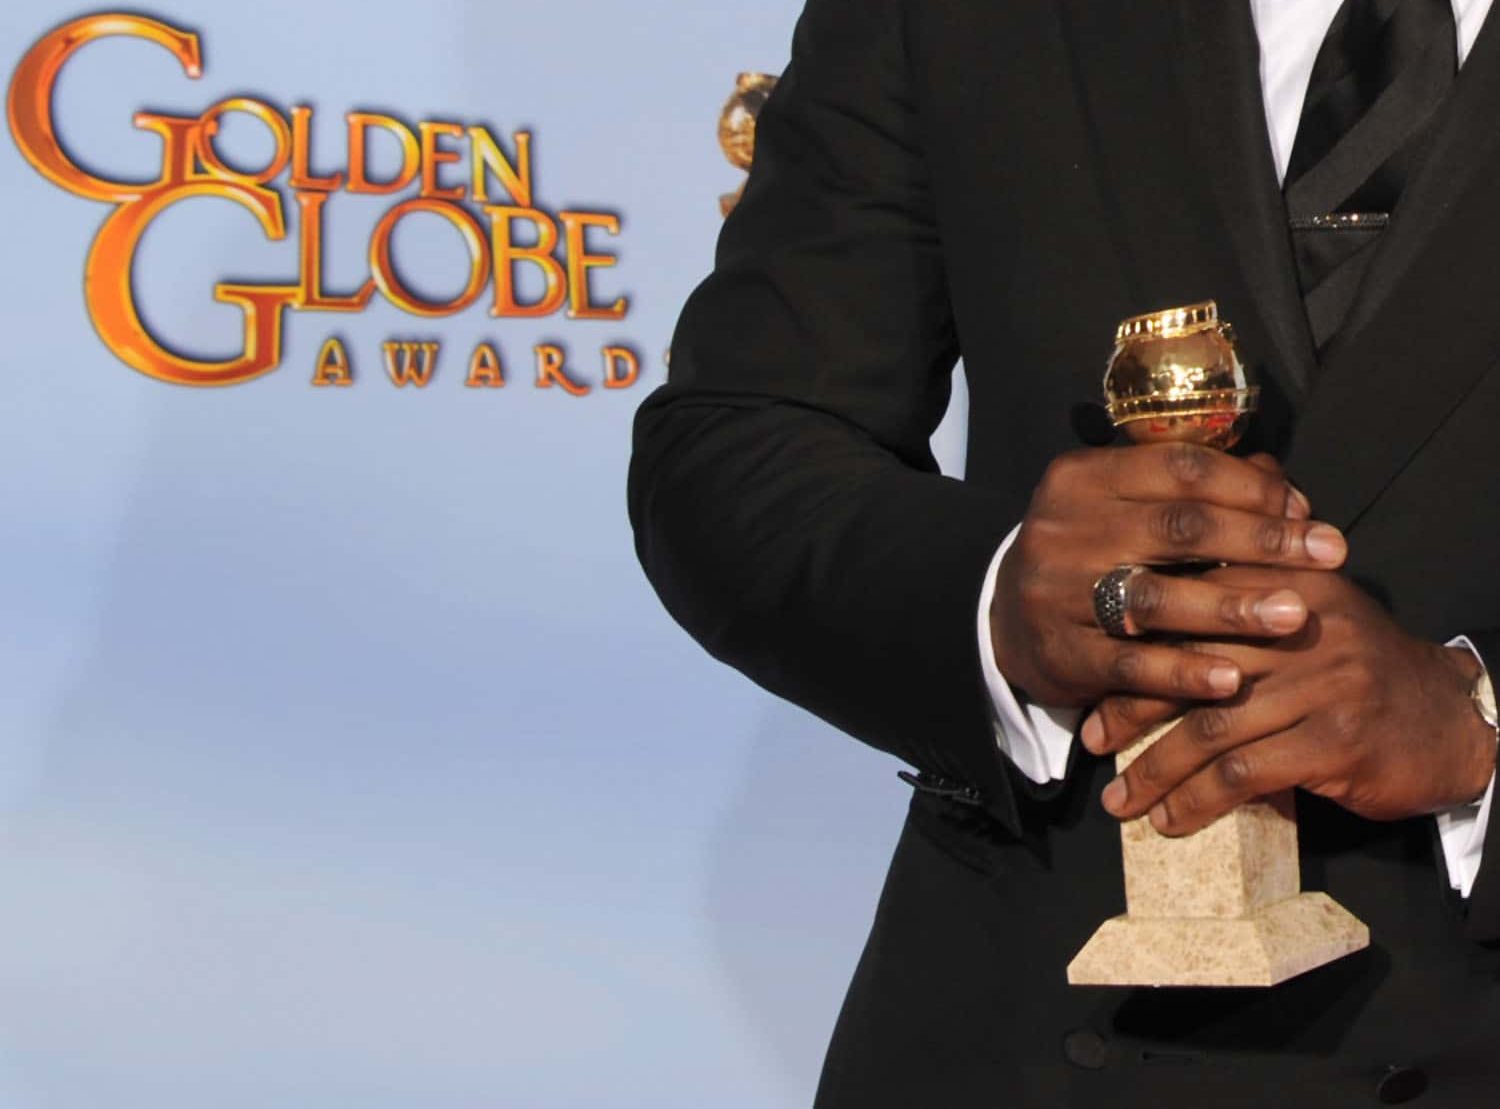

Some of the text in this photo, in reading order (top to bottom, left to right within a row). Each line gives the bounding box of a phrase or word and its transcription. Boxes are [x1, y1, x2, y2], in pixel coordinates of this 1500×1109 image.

[6, 12, 532, 206] GOLDEN
[84, 178, 627, 385] GLOBE
[312, 338, 671, 396] AWARD
